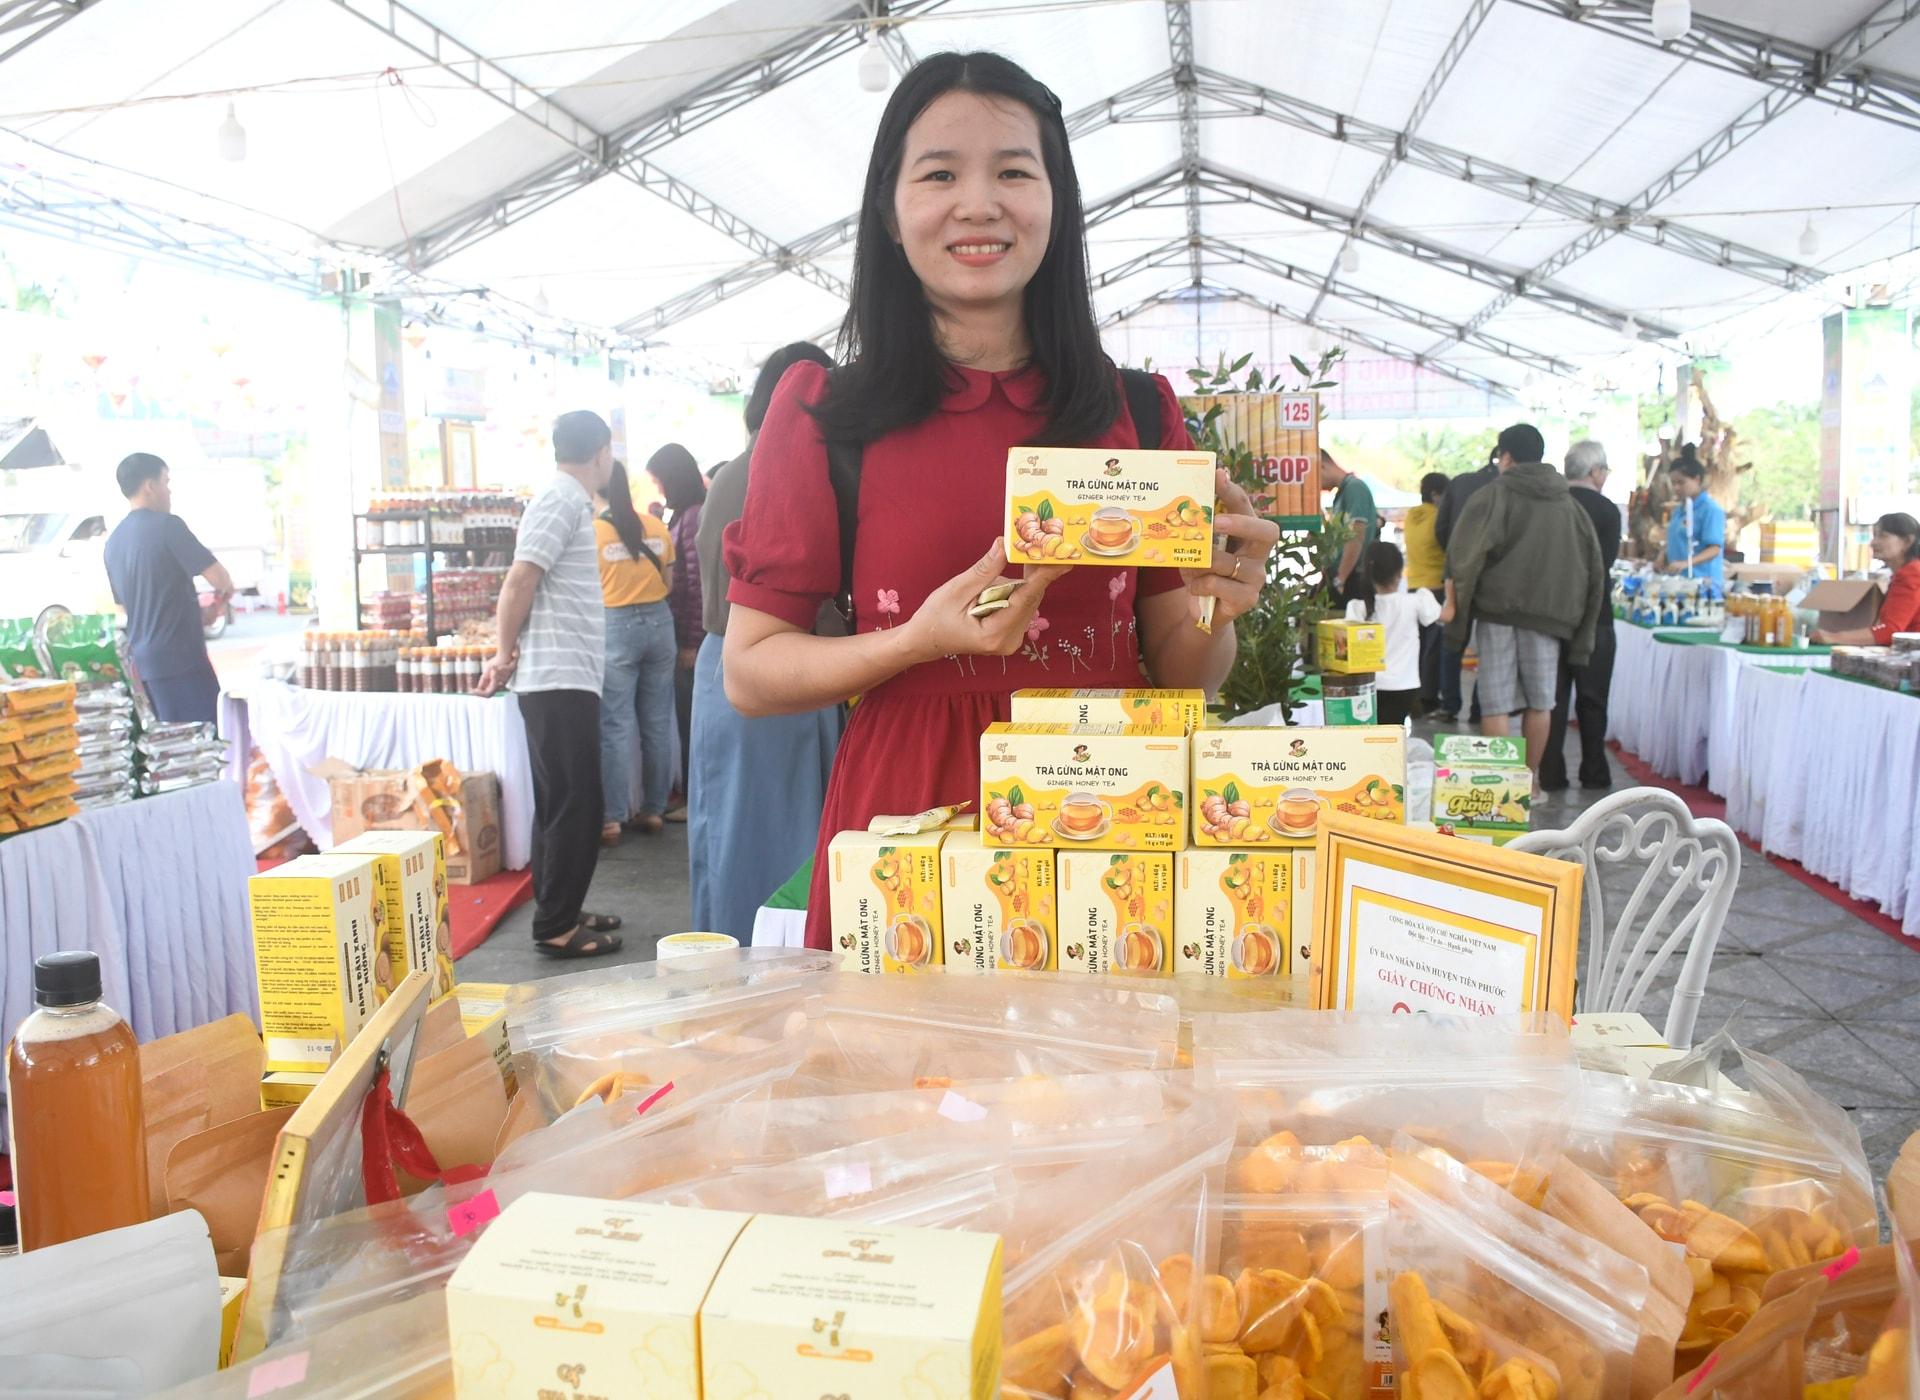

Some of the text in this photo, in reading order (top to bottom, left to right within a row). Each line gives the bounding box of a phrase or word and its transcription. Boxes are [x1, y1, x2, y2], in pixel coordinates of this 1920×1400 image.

[1284, 403, 1310, 421] 125
[1066, 478, 1086, 489] TRÀ
[1116, 479, 1137, 493] MẬT
[1139, 481, 1159, 491] ONG
[1079, 704, 1089, 724] ONG
[1035, 764, 1055, 775] TRÀ
[1085, 765, 1106, 778] MẬT
[1108, 767, 1128, 777] ONG
[1251, 760, 1271, 771] TRÀ
[1302, 760, 1324, 773] MẬT
[1326, 762, 1347, 771] ONG
[859, 898, 868, 918] ONG
[973, 903, 983, 922] ONG
[1088, 907, 1098, 927] ONG
[1206, 906, 1215, 926] ONG
[858, 919, 871, 939] MẬT
[973, 924, 986, 944] MẬT
[1086, 928, 1099, 949] MẬT
[1204, 928, 1216, 949] MẬT
[1482, 942, 1497, 951] NAM
[1380, 950, 1394, 961] BAN
[1395, 954, 1415, 968] NHÂN
[1416, 960, 1431, 973] DÂN
[1432, 968, 1458, 982] HUYỆN
[1377, 967, 1496, 1017] GIẤY CHỨNG NHẬN
